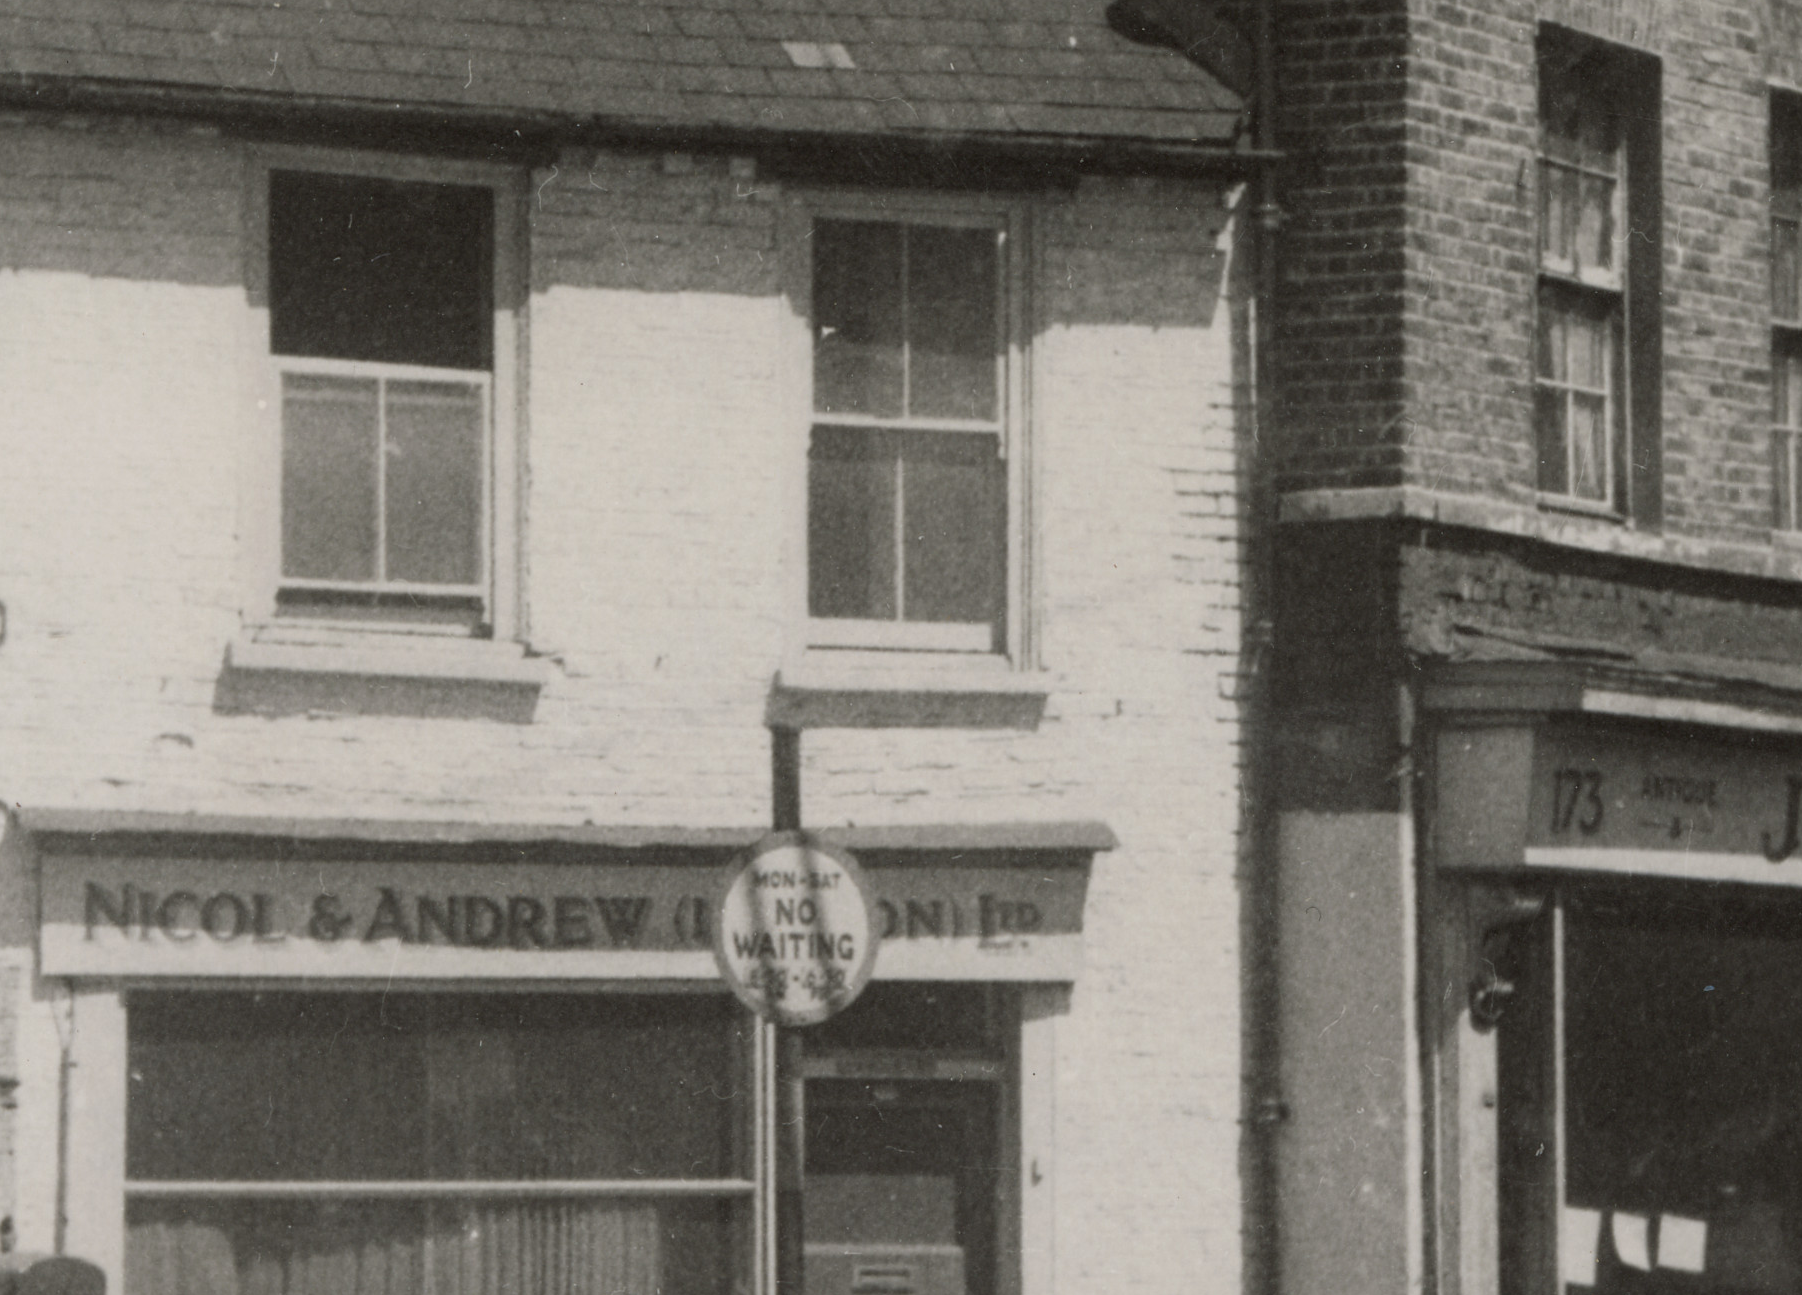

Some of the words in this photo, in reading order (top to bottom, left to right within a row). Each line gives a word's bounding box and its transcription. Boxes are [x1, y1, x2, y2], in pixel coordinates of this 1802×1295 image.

[1551, 767, 1603, 836] 173
[84, 880, 289, 943] NICOL
[308, 892, 353, 943] &
[364, 885, 651, 950] ANDREW
[775, 897, 818, 926] NO
[732, 932, 854, 961] WAITING
